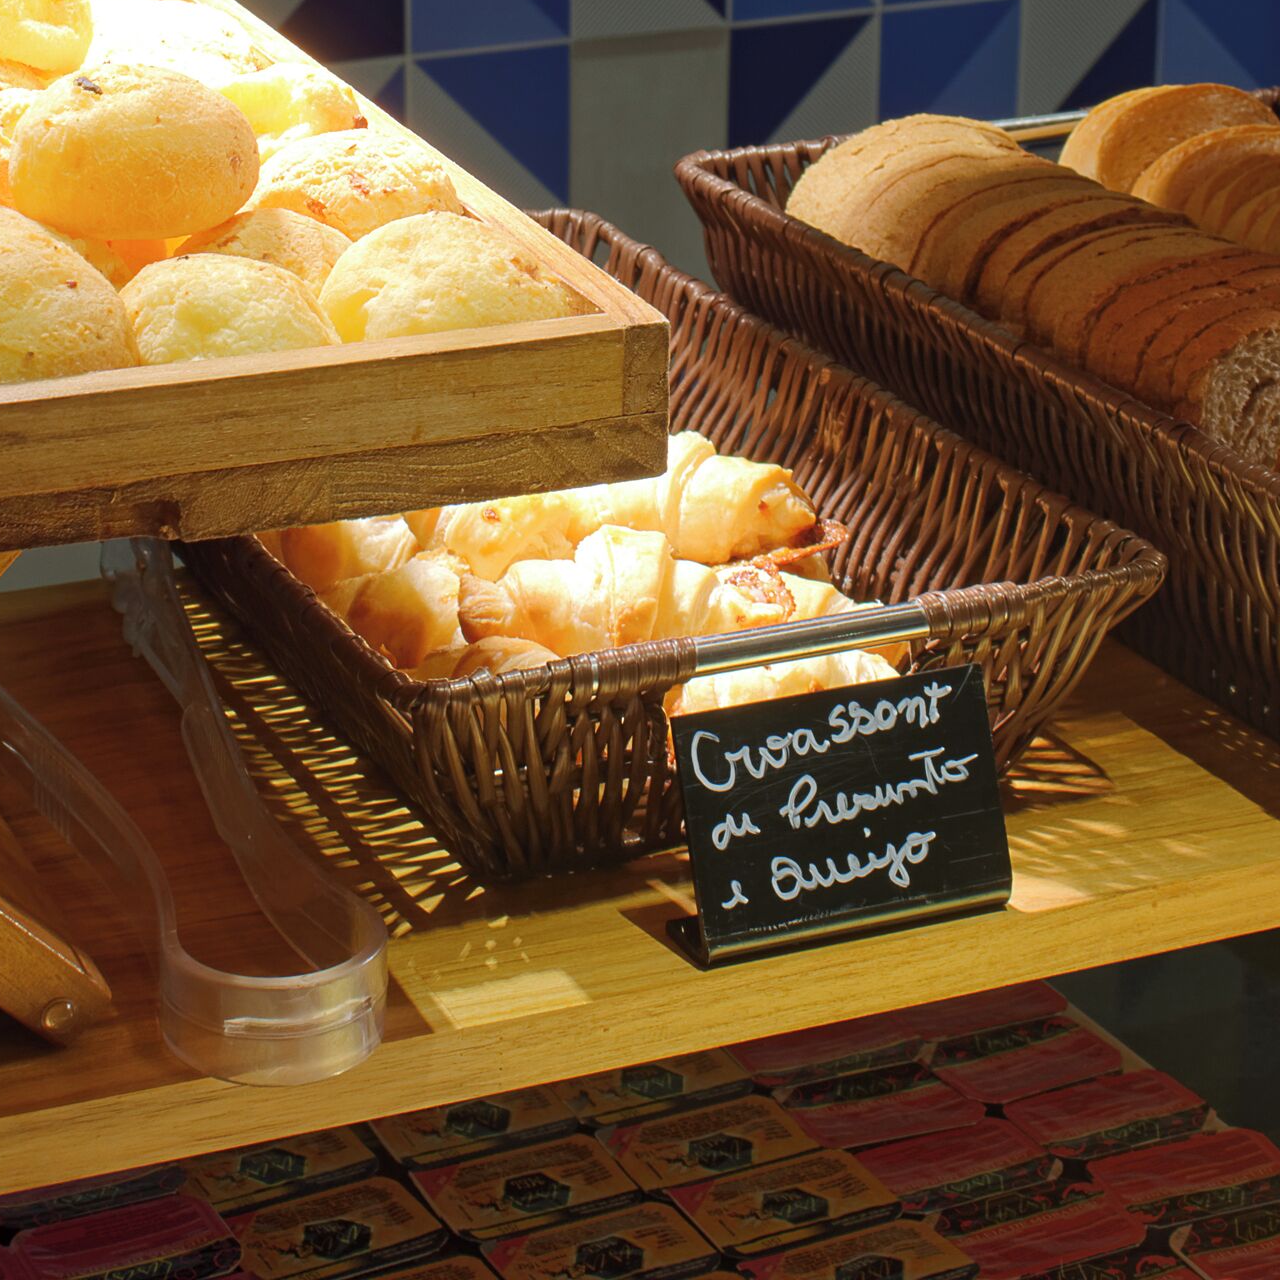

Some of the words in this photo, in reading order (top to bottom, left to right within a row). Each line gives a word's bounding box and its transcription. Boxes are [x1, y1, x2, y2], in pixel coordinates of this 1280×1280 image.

[711, 812, 761, 851] de
[779, 747, 979, 830] Presunto
[771, 827, 937, 901] Queijo
